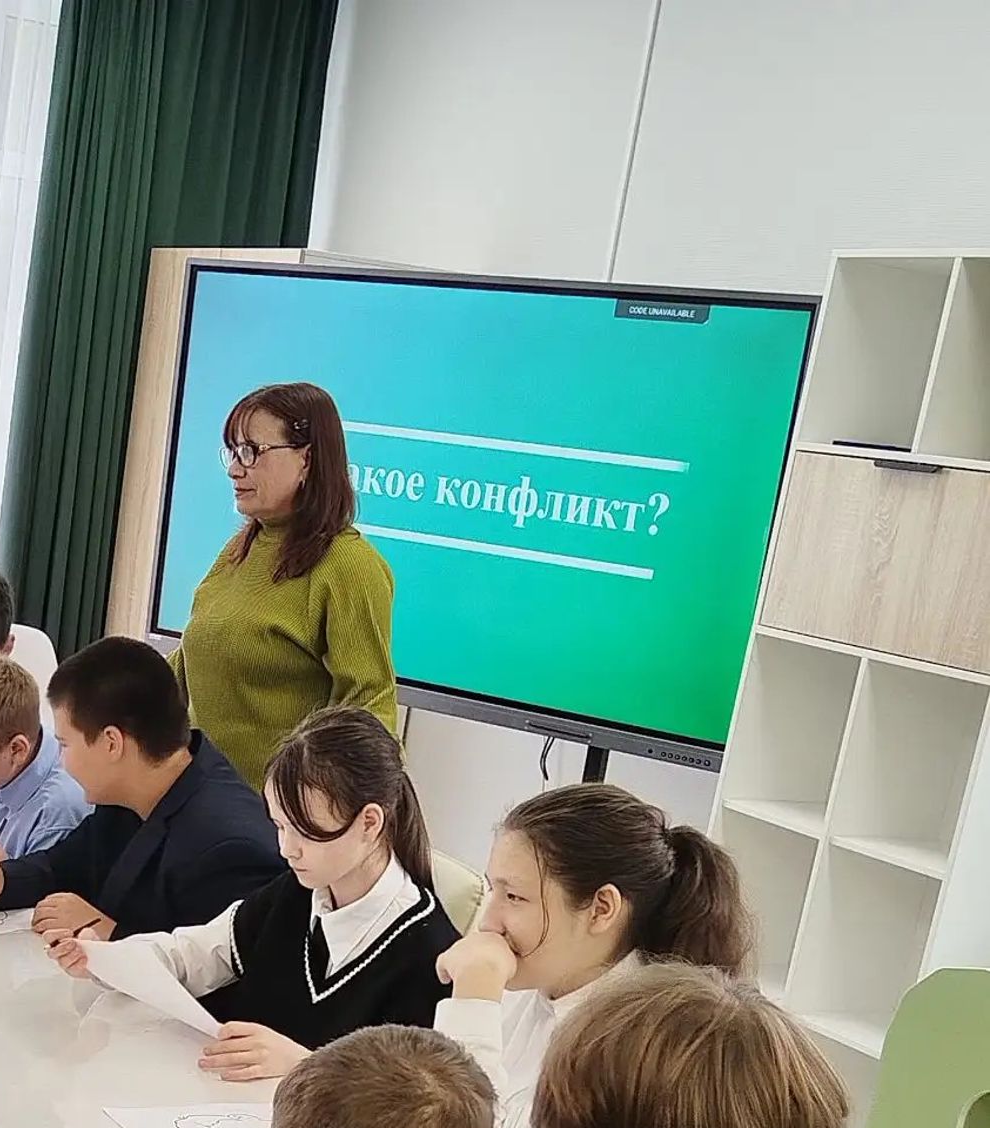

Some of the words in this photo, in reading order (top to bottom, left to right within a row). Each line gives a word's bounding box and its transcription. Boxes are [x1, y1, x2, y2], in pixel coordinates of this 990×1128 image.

[629, 306, 648, 315] CODE
[648, 307, 696, 318] UNAVAILABLE
[347, 463, 425, 500] акое
[434, 474, 670, 536] конфликт?
